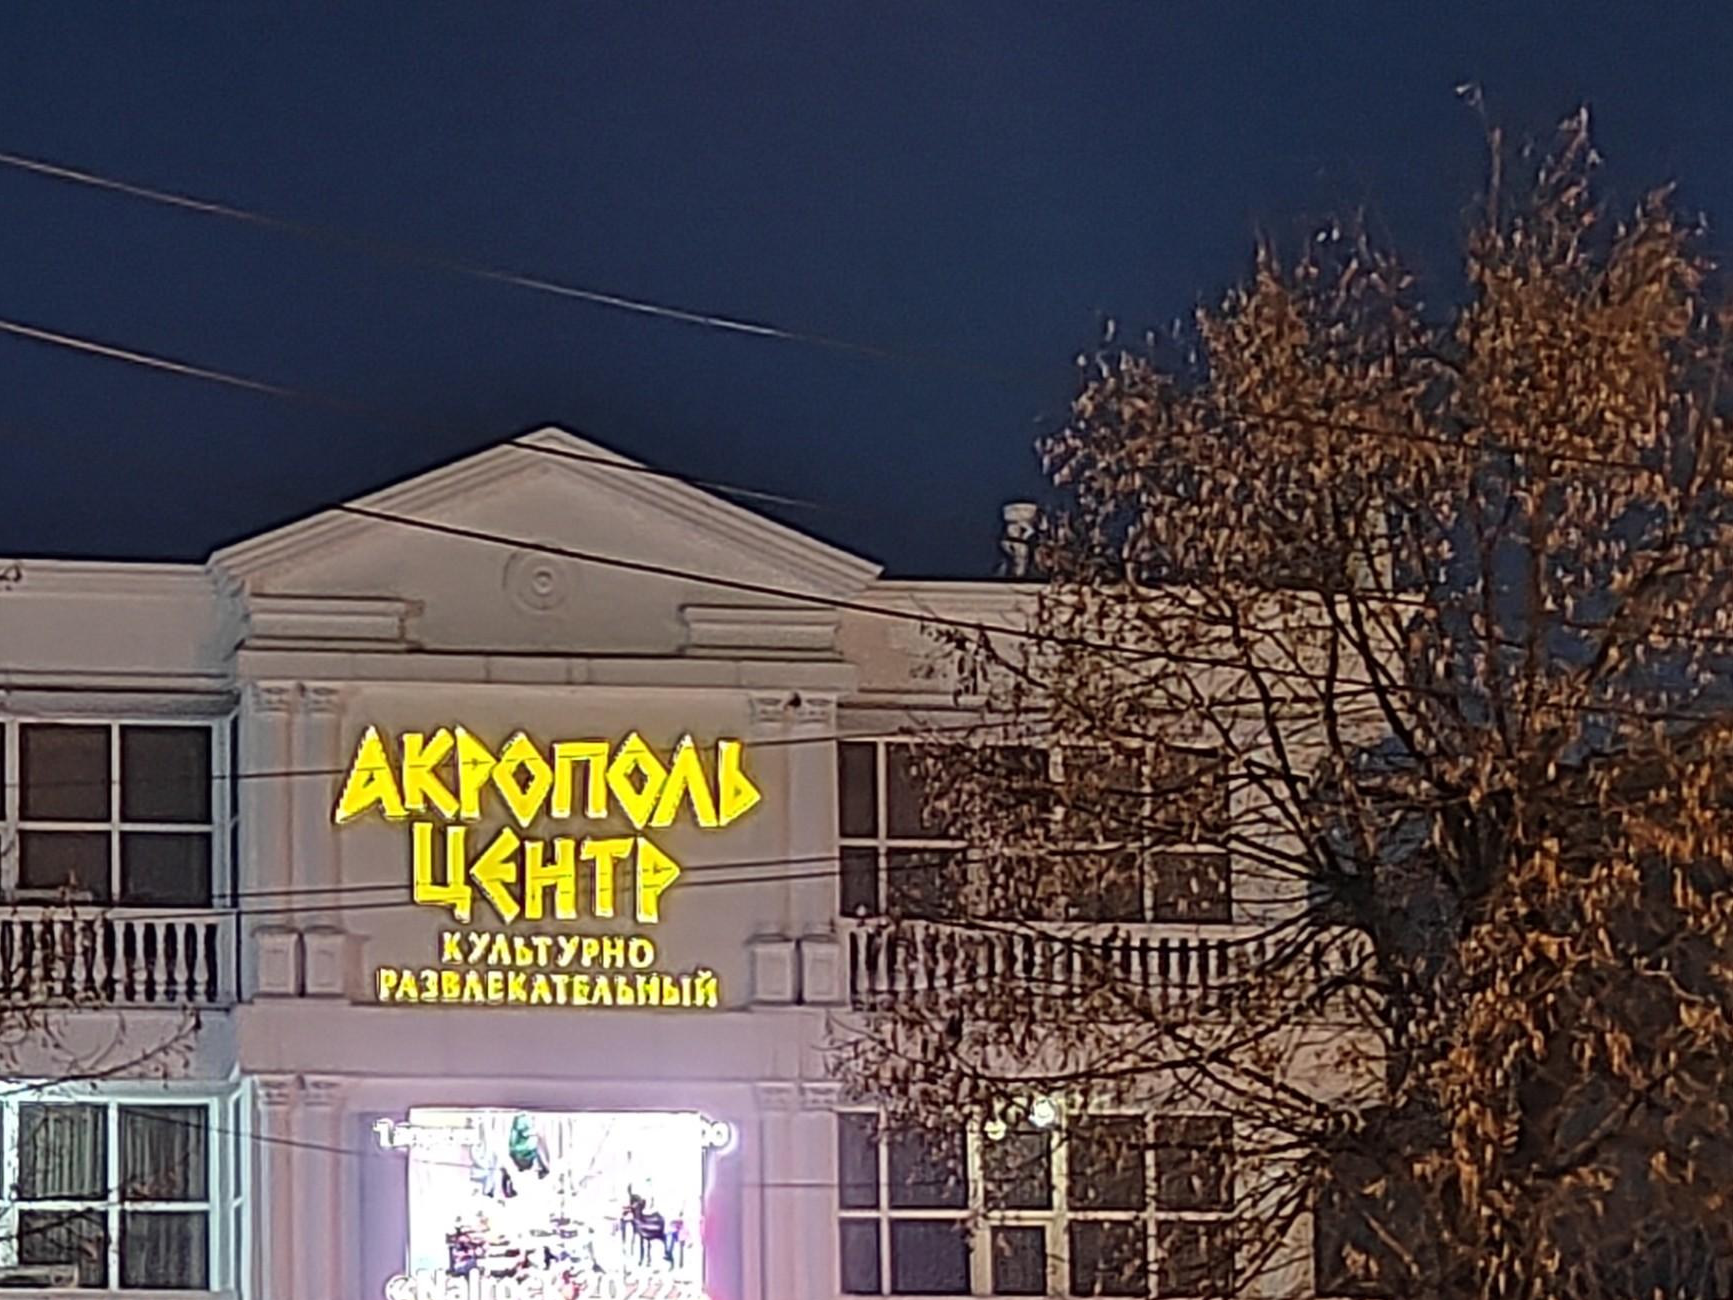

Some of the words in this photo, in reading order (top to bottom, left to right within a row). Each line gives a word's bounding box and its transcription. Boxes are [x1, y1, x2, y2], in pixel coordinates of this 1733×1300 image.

[334, 725, 761, 829] АКРОПОЛЬ
[413, 821, 681, 924] ЦЕНТР
[442, 931, 655, 967] КУЛЬТУРНО
[378, 968, 718, 1008] РАЗВЛЕКАТЕЛЬНЫЙ
